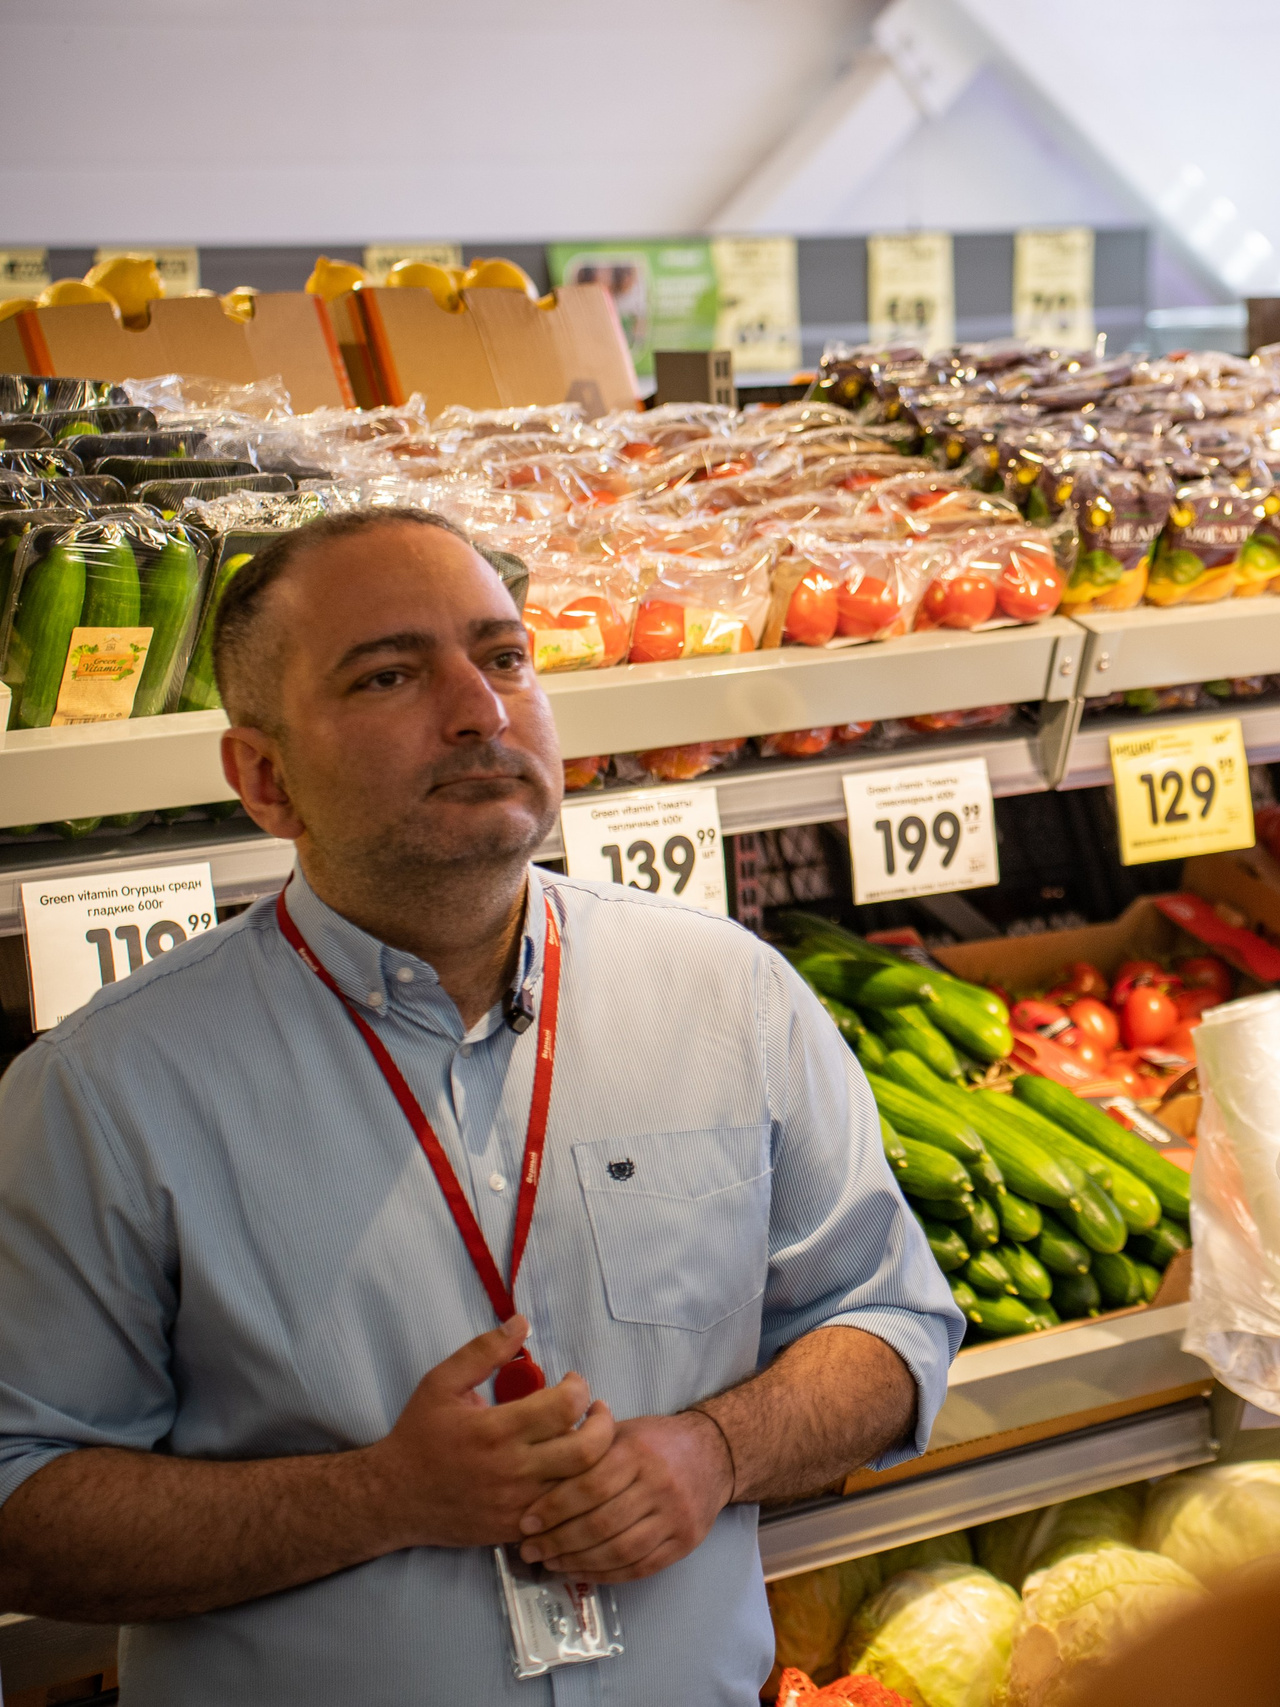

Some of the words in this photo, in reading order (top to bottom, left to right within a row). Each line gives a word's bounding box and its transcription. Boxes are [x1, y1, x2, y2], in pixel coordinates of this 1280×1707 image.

[83, 663, 123, 673] Vitamin
[1139, 765, 1216, 825] 129
[591, 808, 619, 820] Green
[621, 804, 654, 816] vitamin
[656, 799, 693, 811] Томаты
[963, 804, 980, 820] 99
[607, 819, 660, 832] тепличные
[697, 828, 716, 845] 99
[875, 811, 961, 875] 199
[602, 835, 695, 895] 139
[39, 893, 75, 906] Green
[78, 887, 119, 902] vitamin
[121, 884, 166, 901] Огурцы
[168, 879, 202, 896] средн
[87, 903, 135, 917] гладкие
[138, 899, 164, 911] 600г
[188, 913, 212, 932] 99
[541, 1029, 552, 1059] Верный
[525, 1151, 537, 1184] Верный
